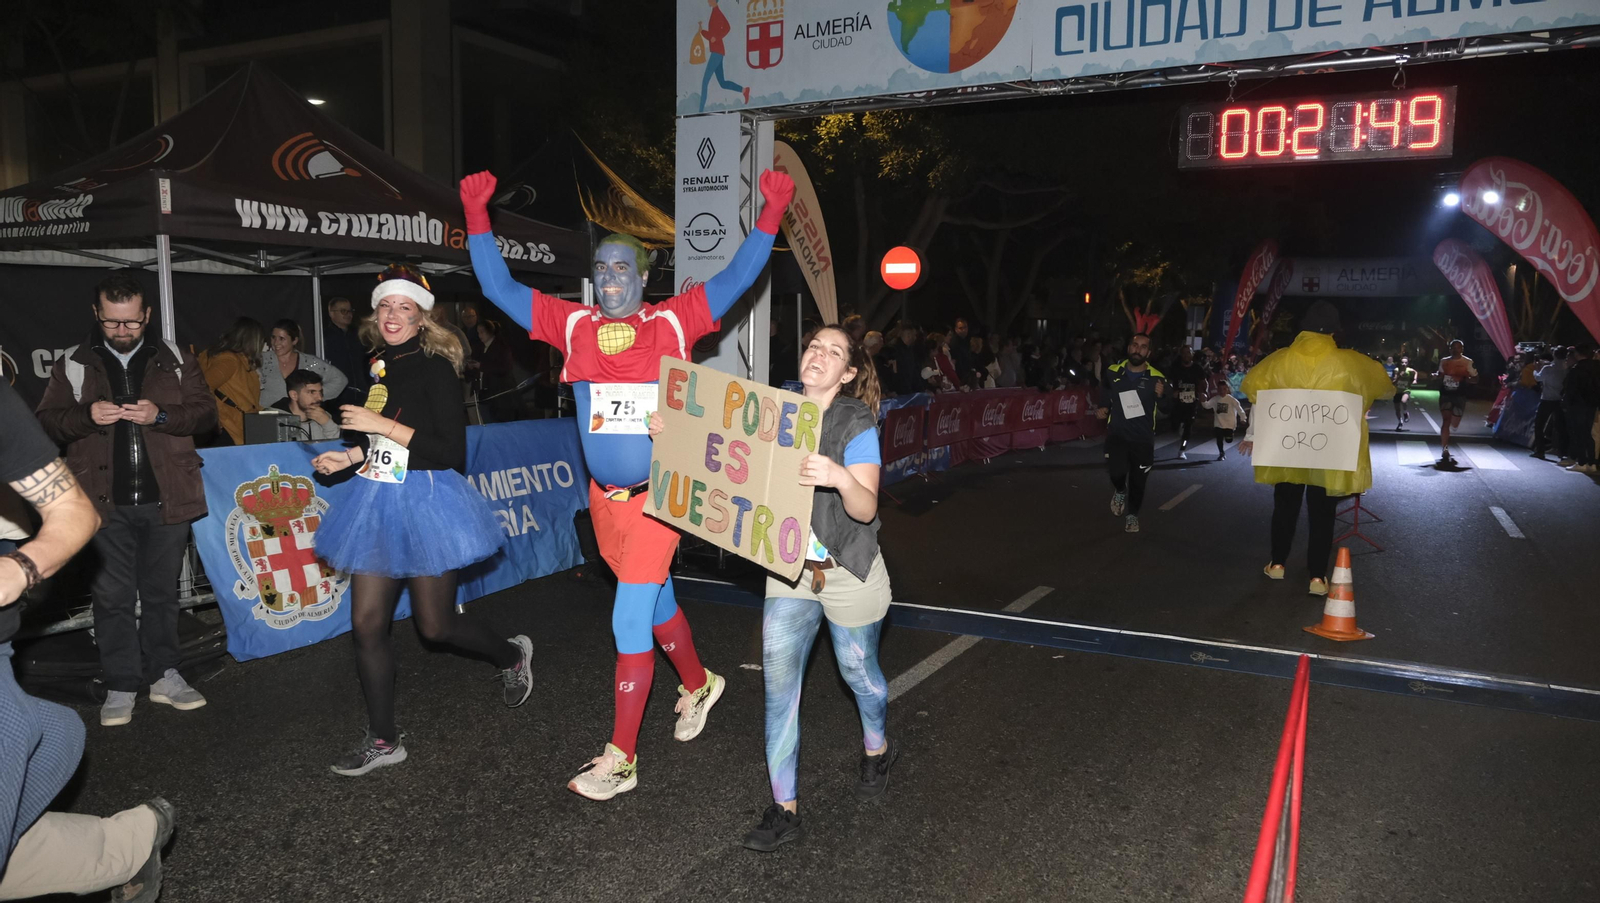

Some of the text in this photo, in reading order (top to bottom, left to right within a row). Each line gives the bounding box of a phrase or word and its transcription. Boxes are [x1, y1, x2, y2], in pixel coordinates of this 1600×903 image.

[794, 12, 872, 41] ALMERÍA
[1054, 0, 1246, 57] CIUDAD
[812, 36, 853, 51] CIUDAD
[683, 175, 729, 186] RENAULT
[46, 221, 91, 236] deportivo
[683, 228, 727, 237] NISSAN
[666, 367, 820, 453] EL PODER
[1268, 402, 1350, 426] COMPRO
[1281, 431, 1329, 452] ORO
[704, 432, 752, 485] ES
[652, 459, 802, 564] VUESTRO
